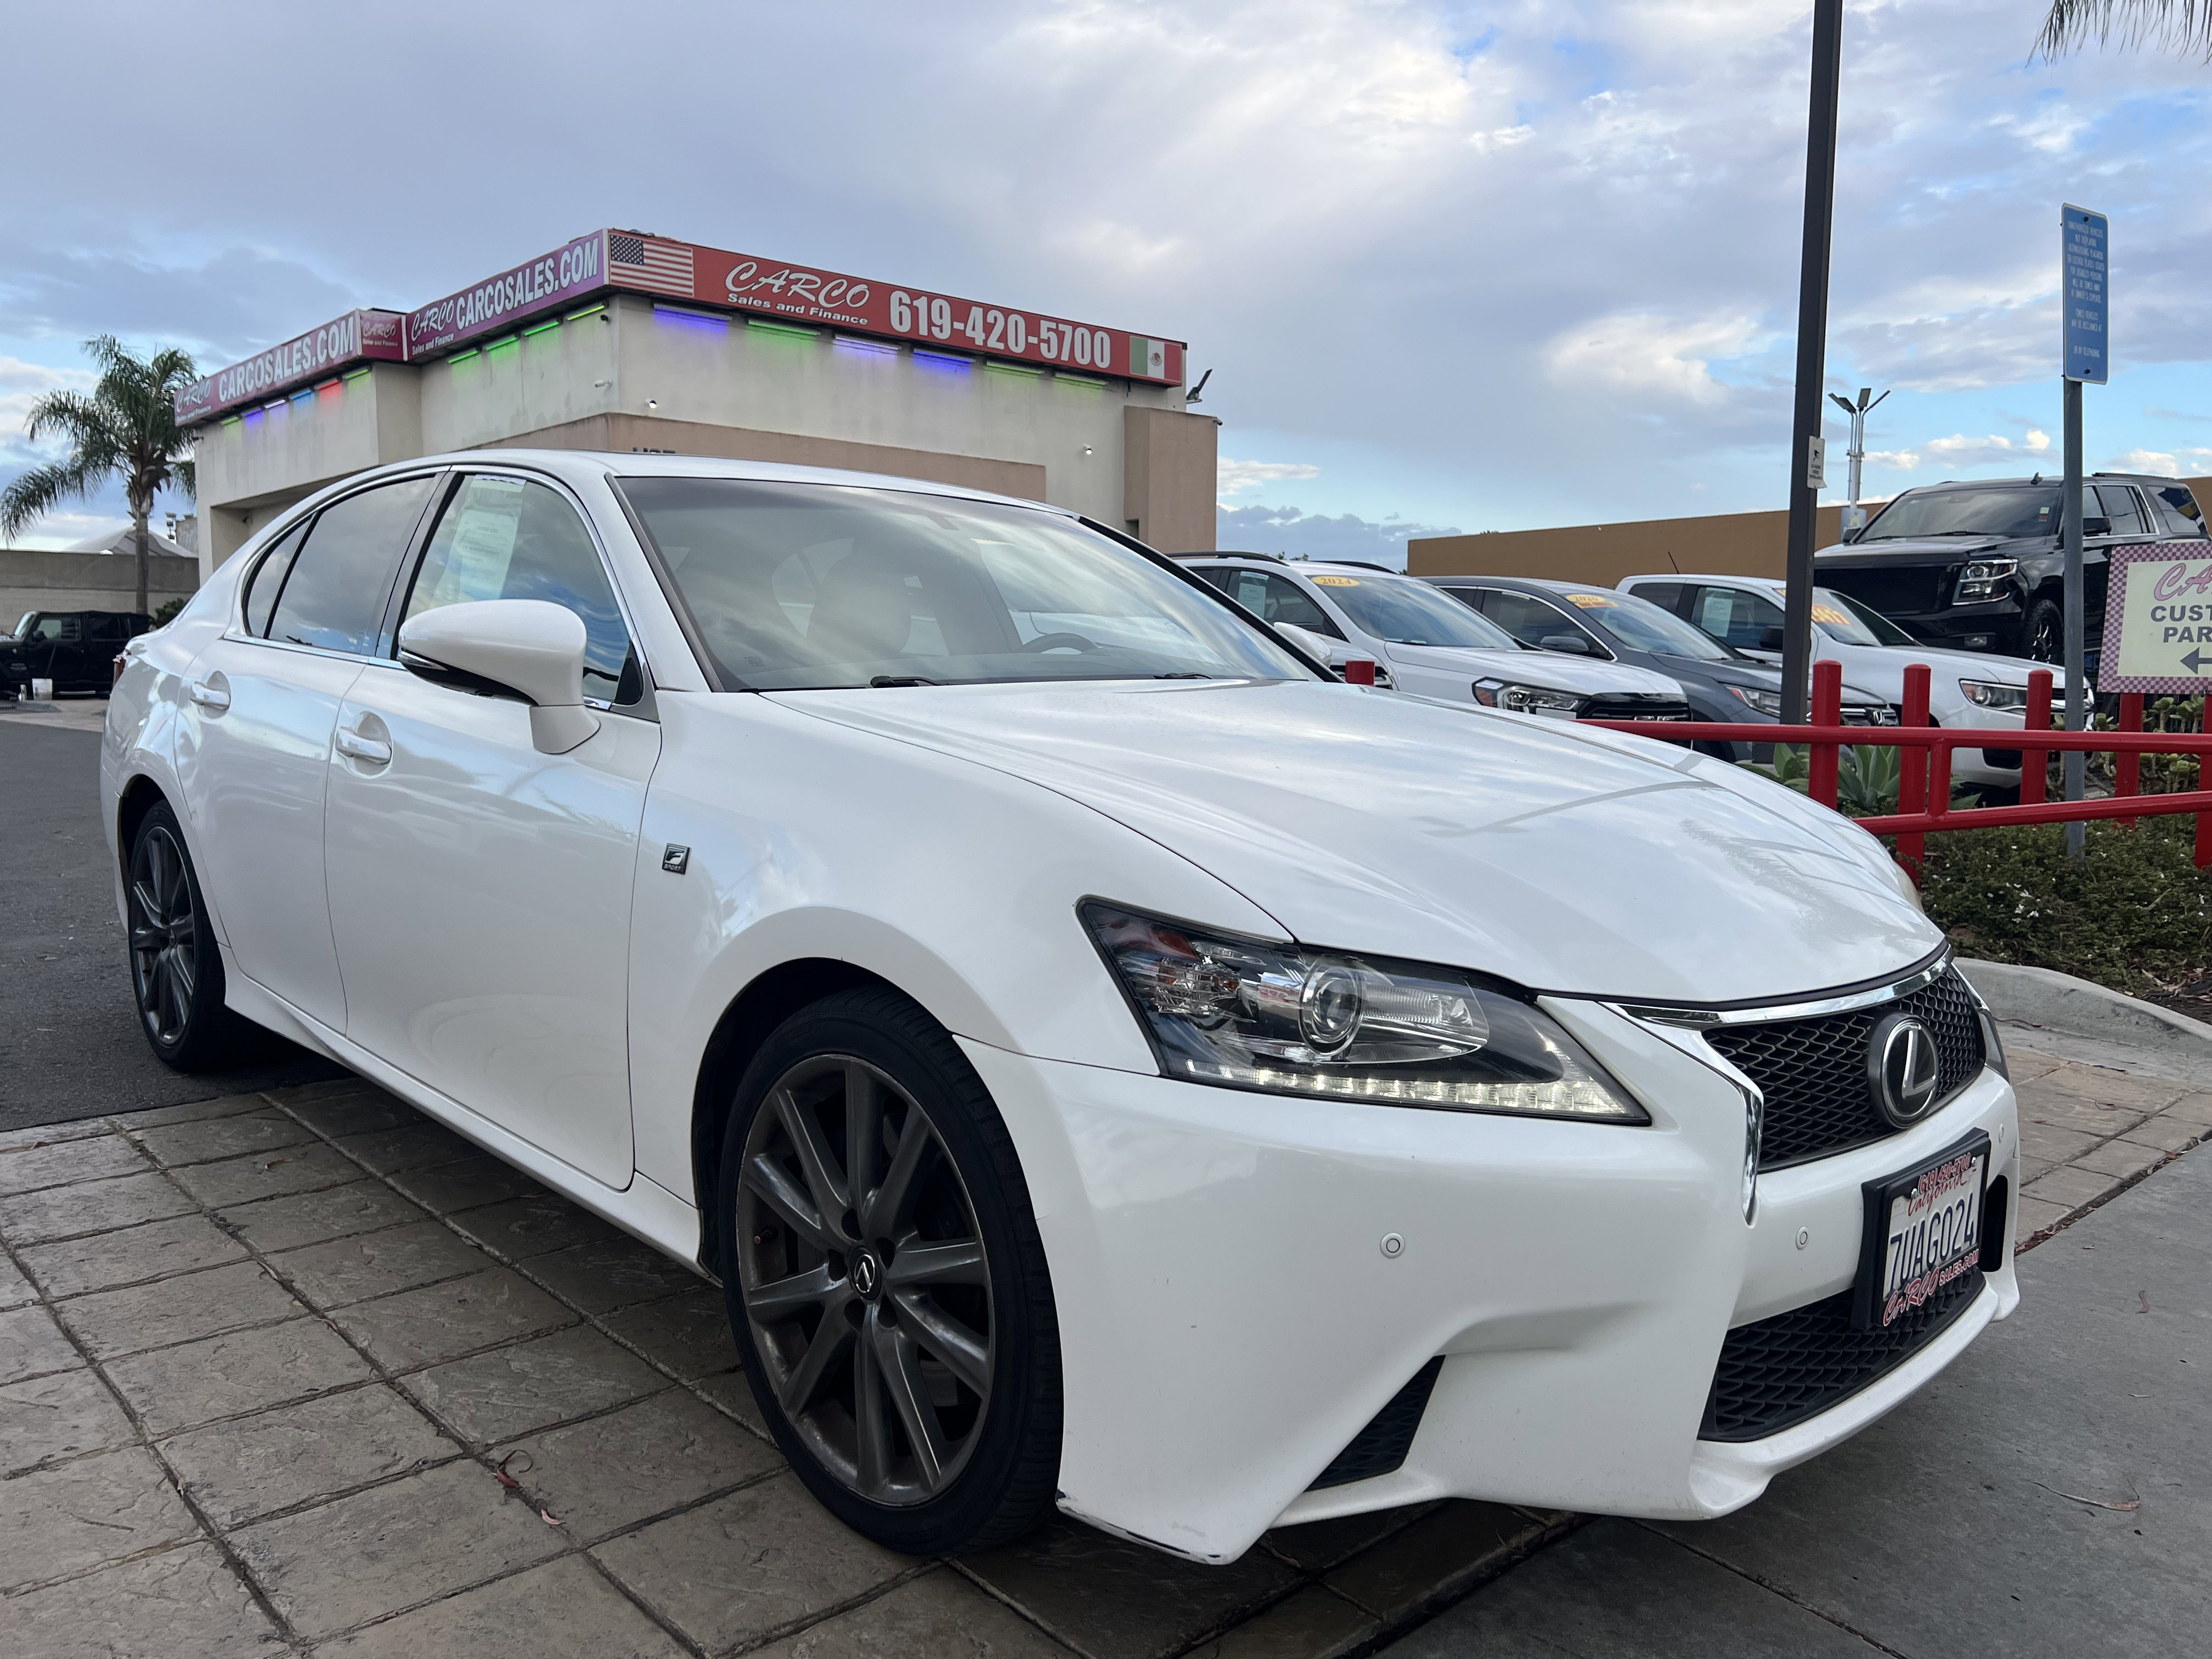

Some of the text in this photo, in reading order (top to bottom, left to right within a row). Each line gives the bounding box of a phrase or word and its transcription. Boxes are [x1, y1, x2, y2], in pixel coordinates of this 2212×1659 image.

[456, 238, 599, 330] CARCOSALES.COM
[725, 261, 870, 308] CARCO
[363, 321, 396, 338] CARCO
[411, 299, 454, 342] CARCO
[727, 292, 868, 325] Sales and Finance
[889, 290, 1111, 370] 619-420-5700
[219, 317, 354, 403] CARCOSALES.COM
[177, 379, 211, 413] CARCO
[1908, 1172, 1967, 1216] California
[1917, 1152, 1971, 1194] (619) 420-5700
[1889, 1192, 1974, 1290] 7UAG024
[1883, 1266, 1940, 1327] CARCO
